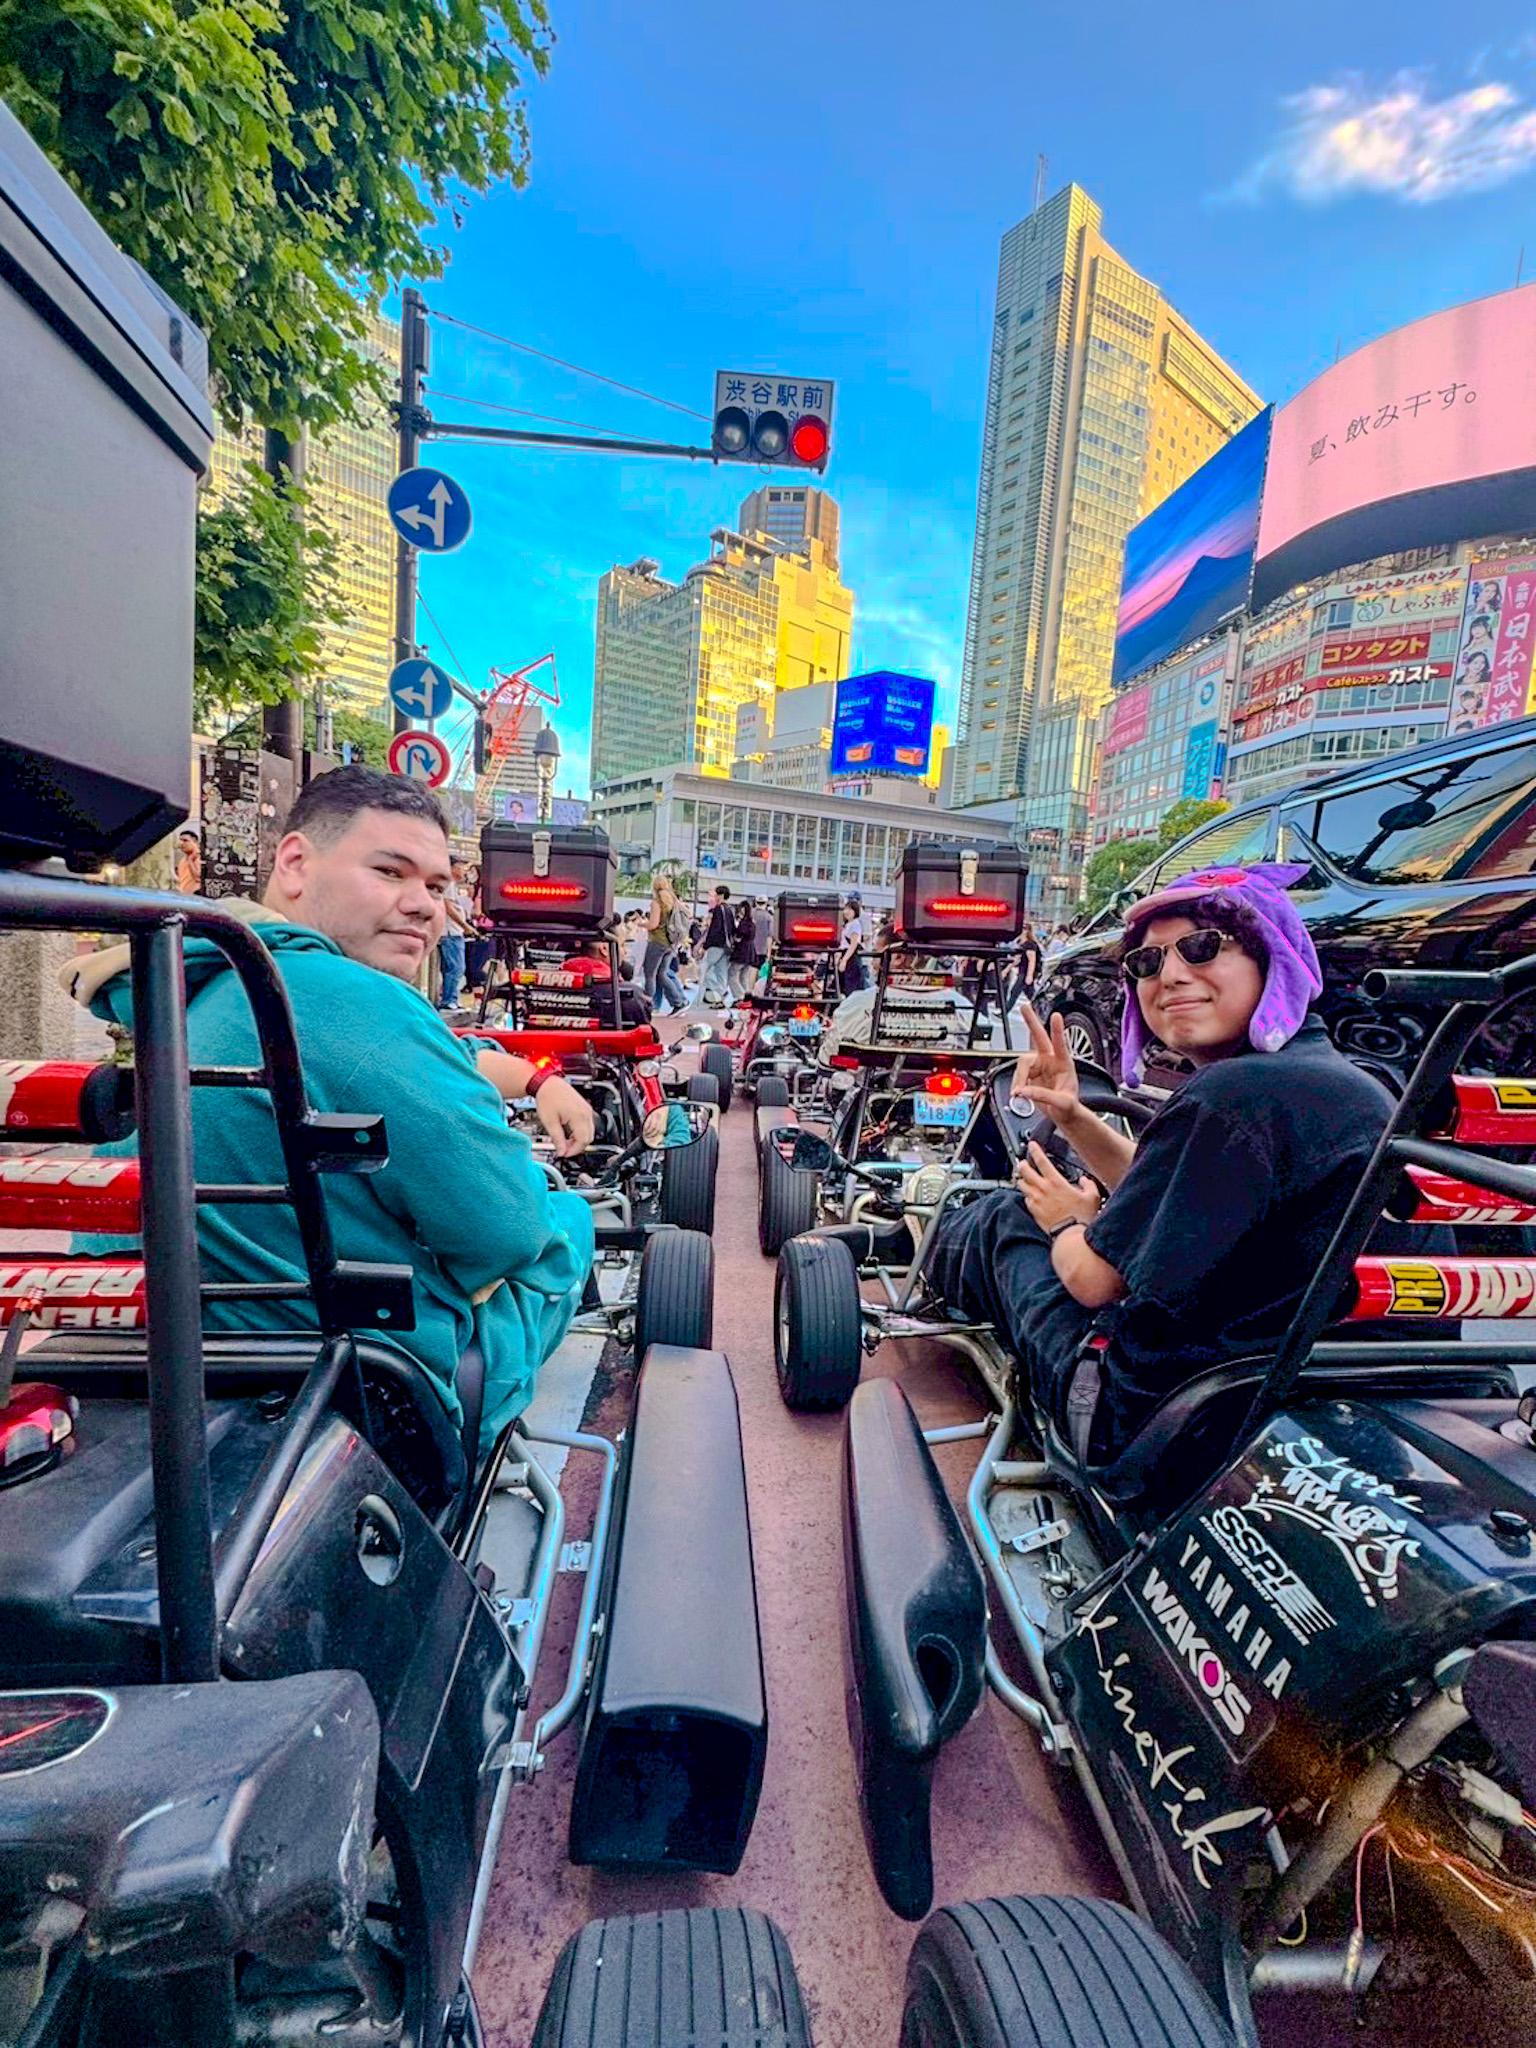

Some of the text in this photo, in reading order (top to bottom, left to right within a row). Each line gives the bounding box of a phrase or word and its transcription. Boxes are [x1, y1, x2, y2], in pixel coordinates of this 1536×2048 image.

[725, 379, 824, 409] 渋谷駅前
[1307, 382, 1477, 466] 夏、飲み干す。
[1391, 588, 1460, 614] しゃぶ葉
[1323, 636, 1427, 664] コンタクト
[1387, 664, 1440, 685] ガスト
[1275, 683, 1305, 706] ガスト
[1387, 1264, 1444, 1312] PRO
[1178, 1534, 1294, 1701] YAMAHA
